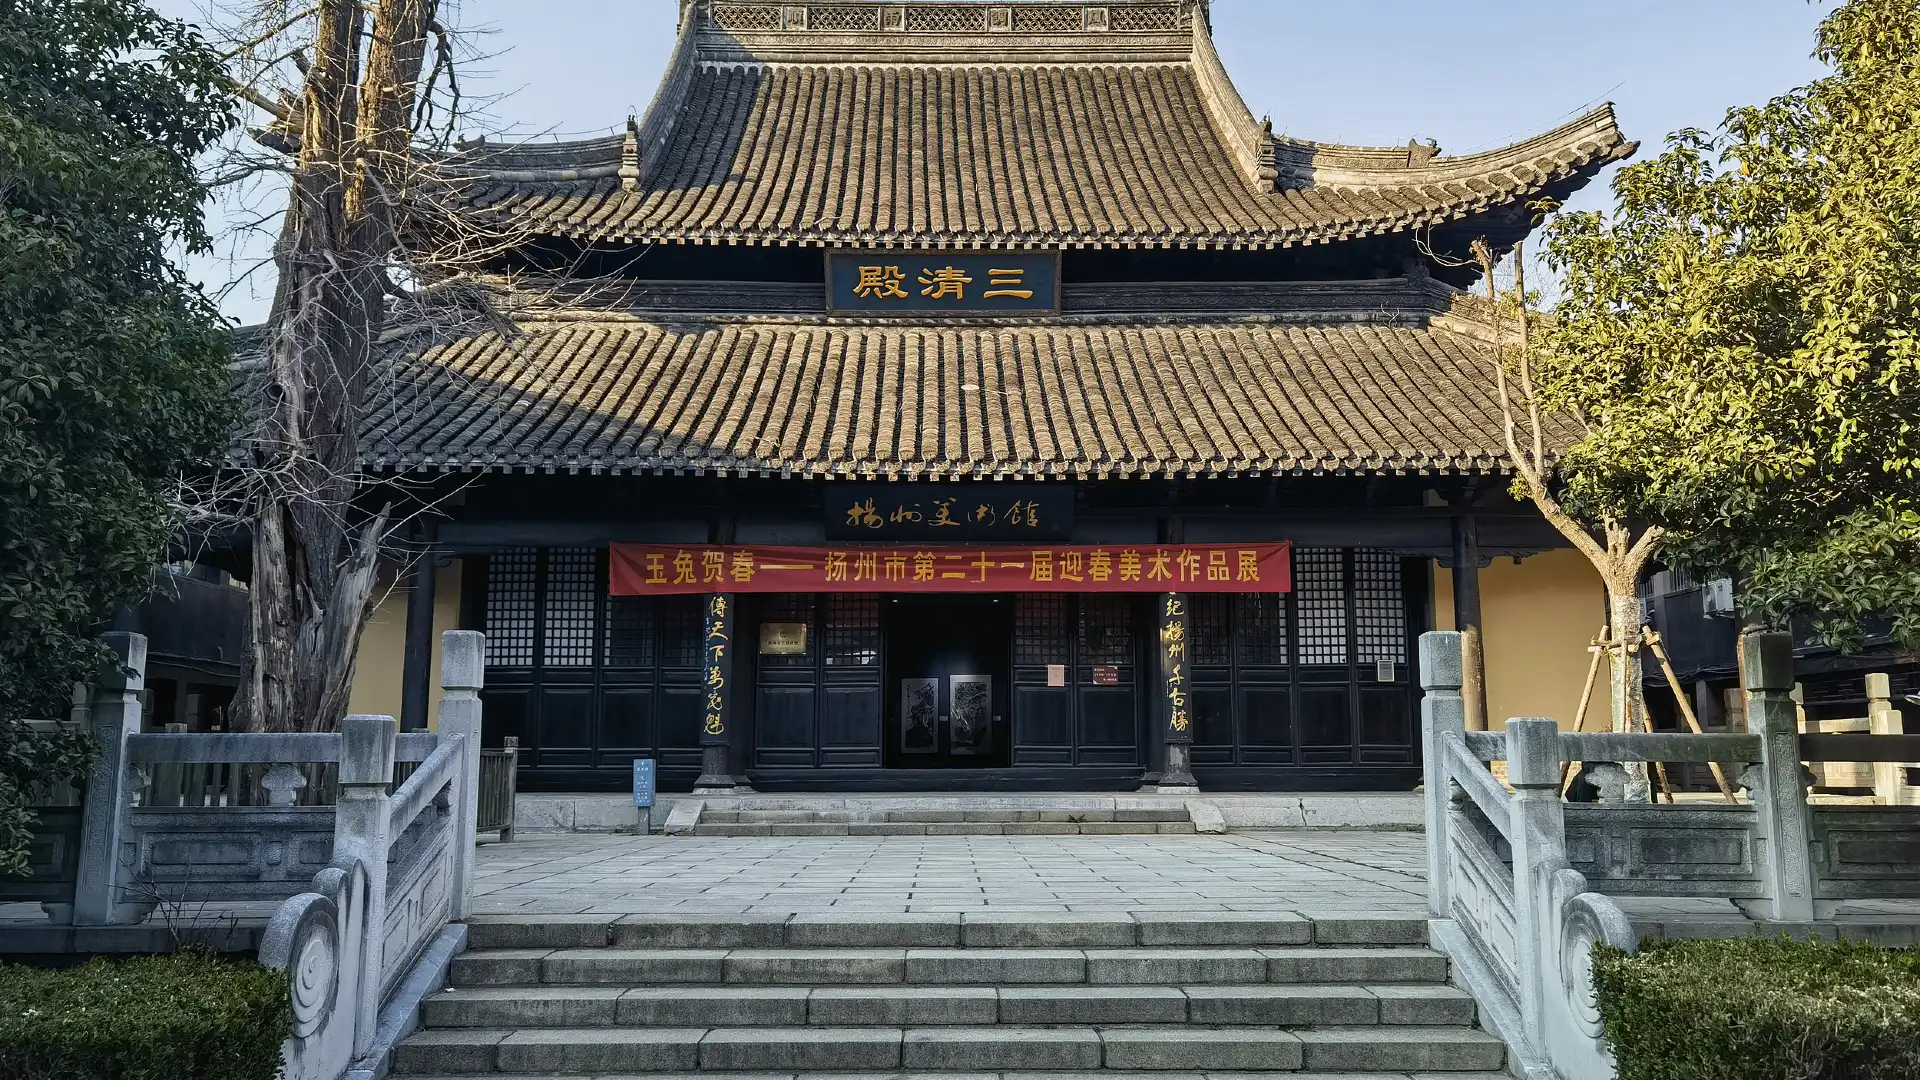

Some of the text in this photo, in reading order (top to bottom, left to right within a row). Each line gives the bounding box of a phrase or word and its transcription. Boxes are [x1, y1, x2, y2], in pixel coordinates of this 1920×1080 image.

[1165, 591, 1189, 732] 紀揚州千古勝
